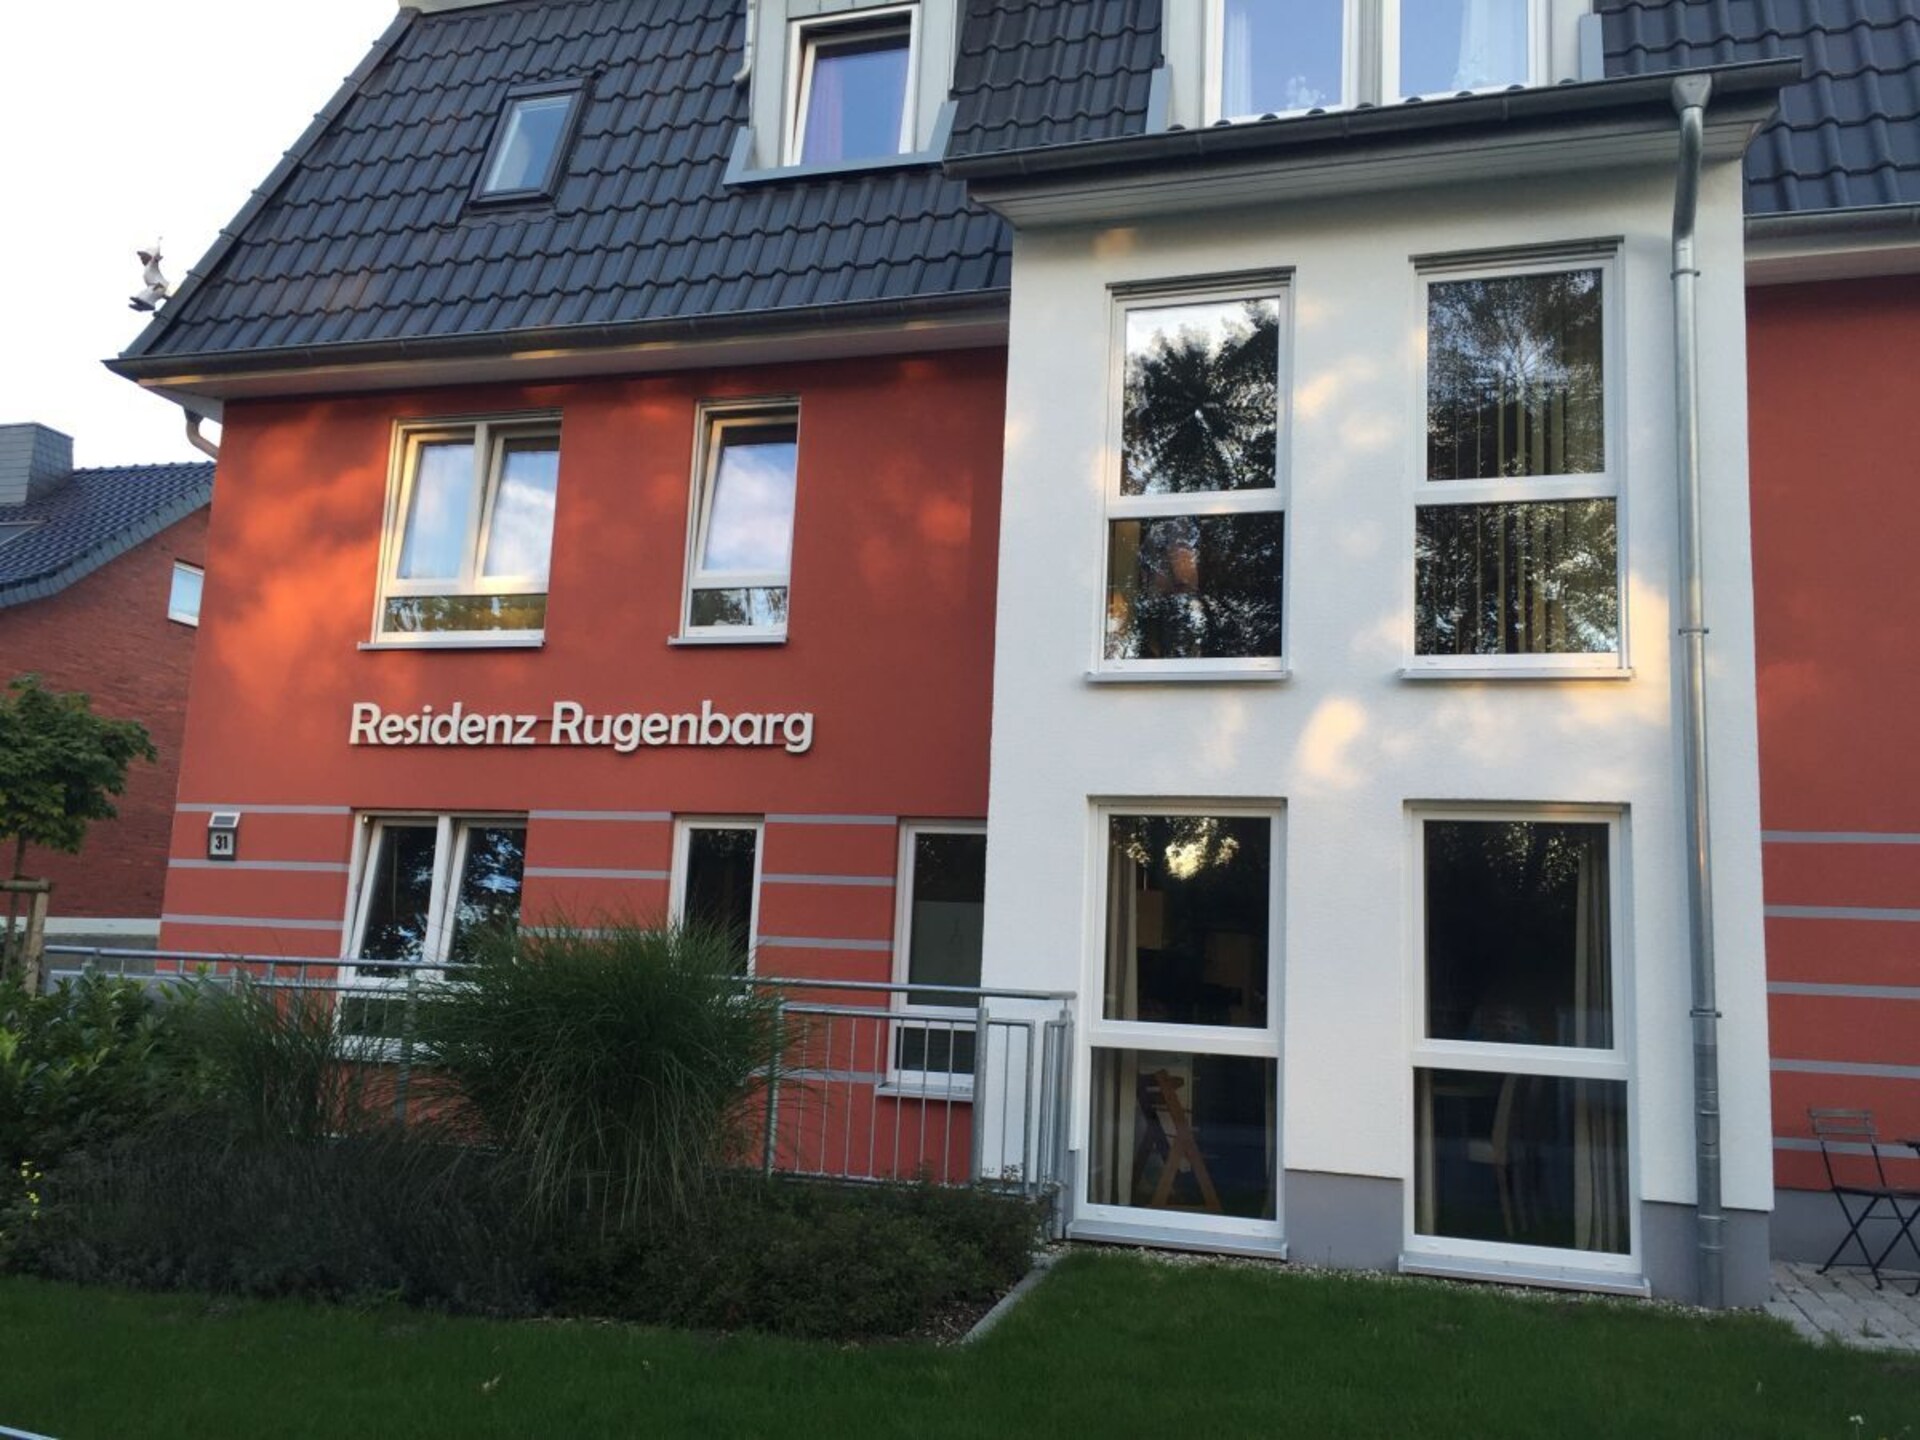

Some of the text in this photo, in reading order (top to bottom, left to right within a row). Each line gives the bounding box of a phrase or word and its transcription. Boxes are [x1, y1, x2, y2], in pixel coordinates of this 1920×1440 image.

[349, 700, 815, 753] Residenz Rugenbarg
[215, 834, 228, 850] 31
